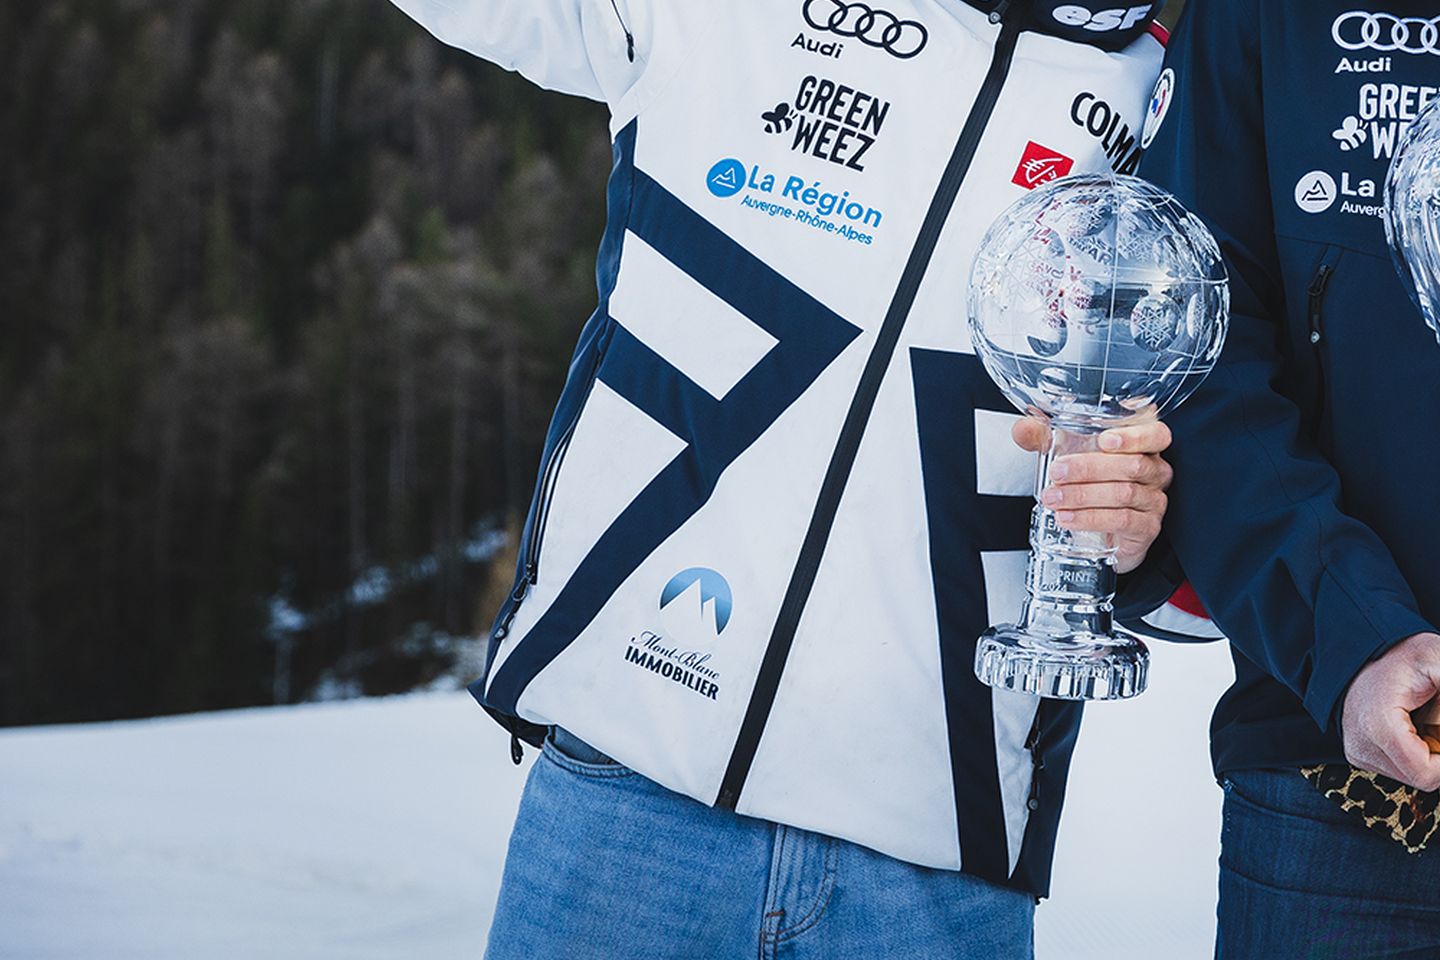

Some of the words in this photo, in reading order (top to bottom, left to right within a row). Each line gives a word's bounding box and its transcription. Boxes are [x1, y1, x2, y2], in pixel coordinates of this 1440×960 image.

[791, 32, 845, 60] Audi
[1335, 56, 1391, 74] Audi
[795, 74, 891, 137] GREEN
[791, 115, 876, 172] WEEZ
[1070, 91, 1142, 176] COLMA
[748, 164, 775, 193] La
[781, 175, 884, 230] Région
[1341, 172, 1376, 198] La
[740, 195, 874, 246] Auvergne-Rhône-Alpes
[624, 645, 720, 701] IMMOBILIER
[631, 630, 721, 681] Mont-Blanc
